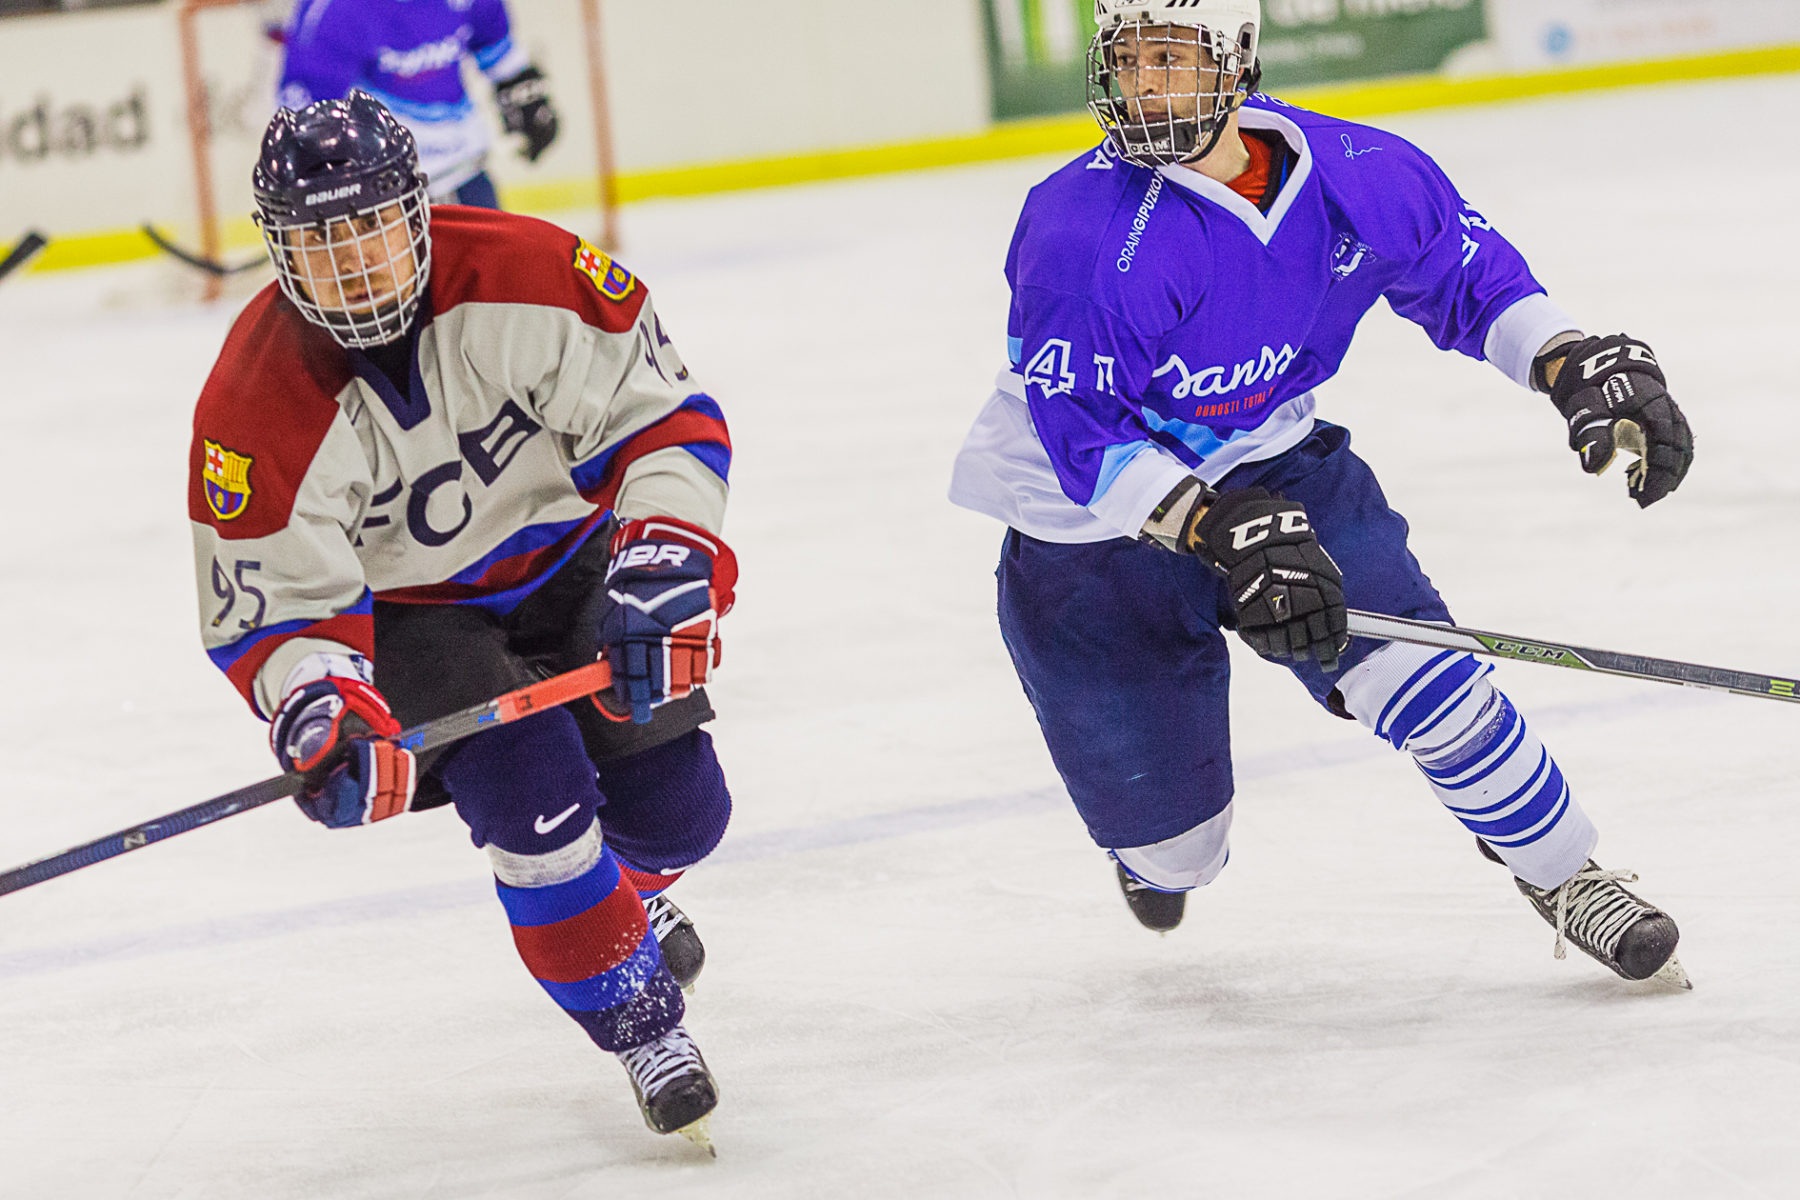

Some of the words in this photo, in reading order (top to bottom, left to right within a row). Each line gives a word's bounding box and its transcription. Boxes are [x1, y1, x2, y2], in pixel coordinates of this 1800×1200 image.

[305, 183, 361, 206] BAUER
[211, 554, 266, 630] 95
[1493, 639, 1567, 661] CCM
